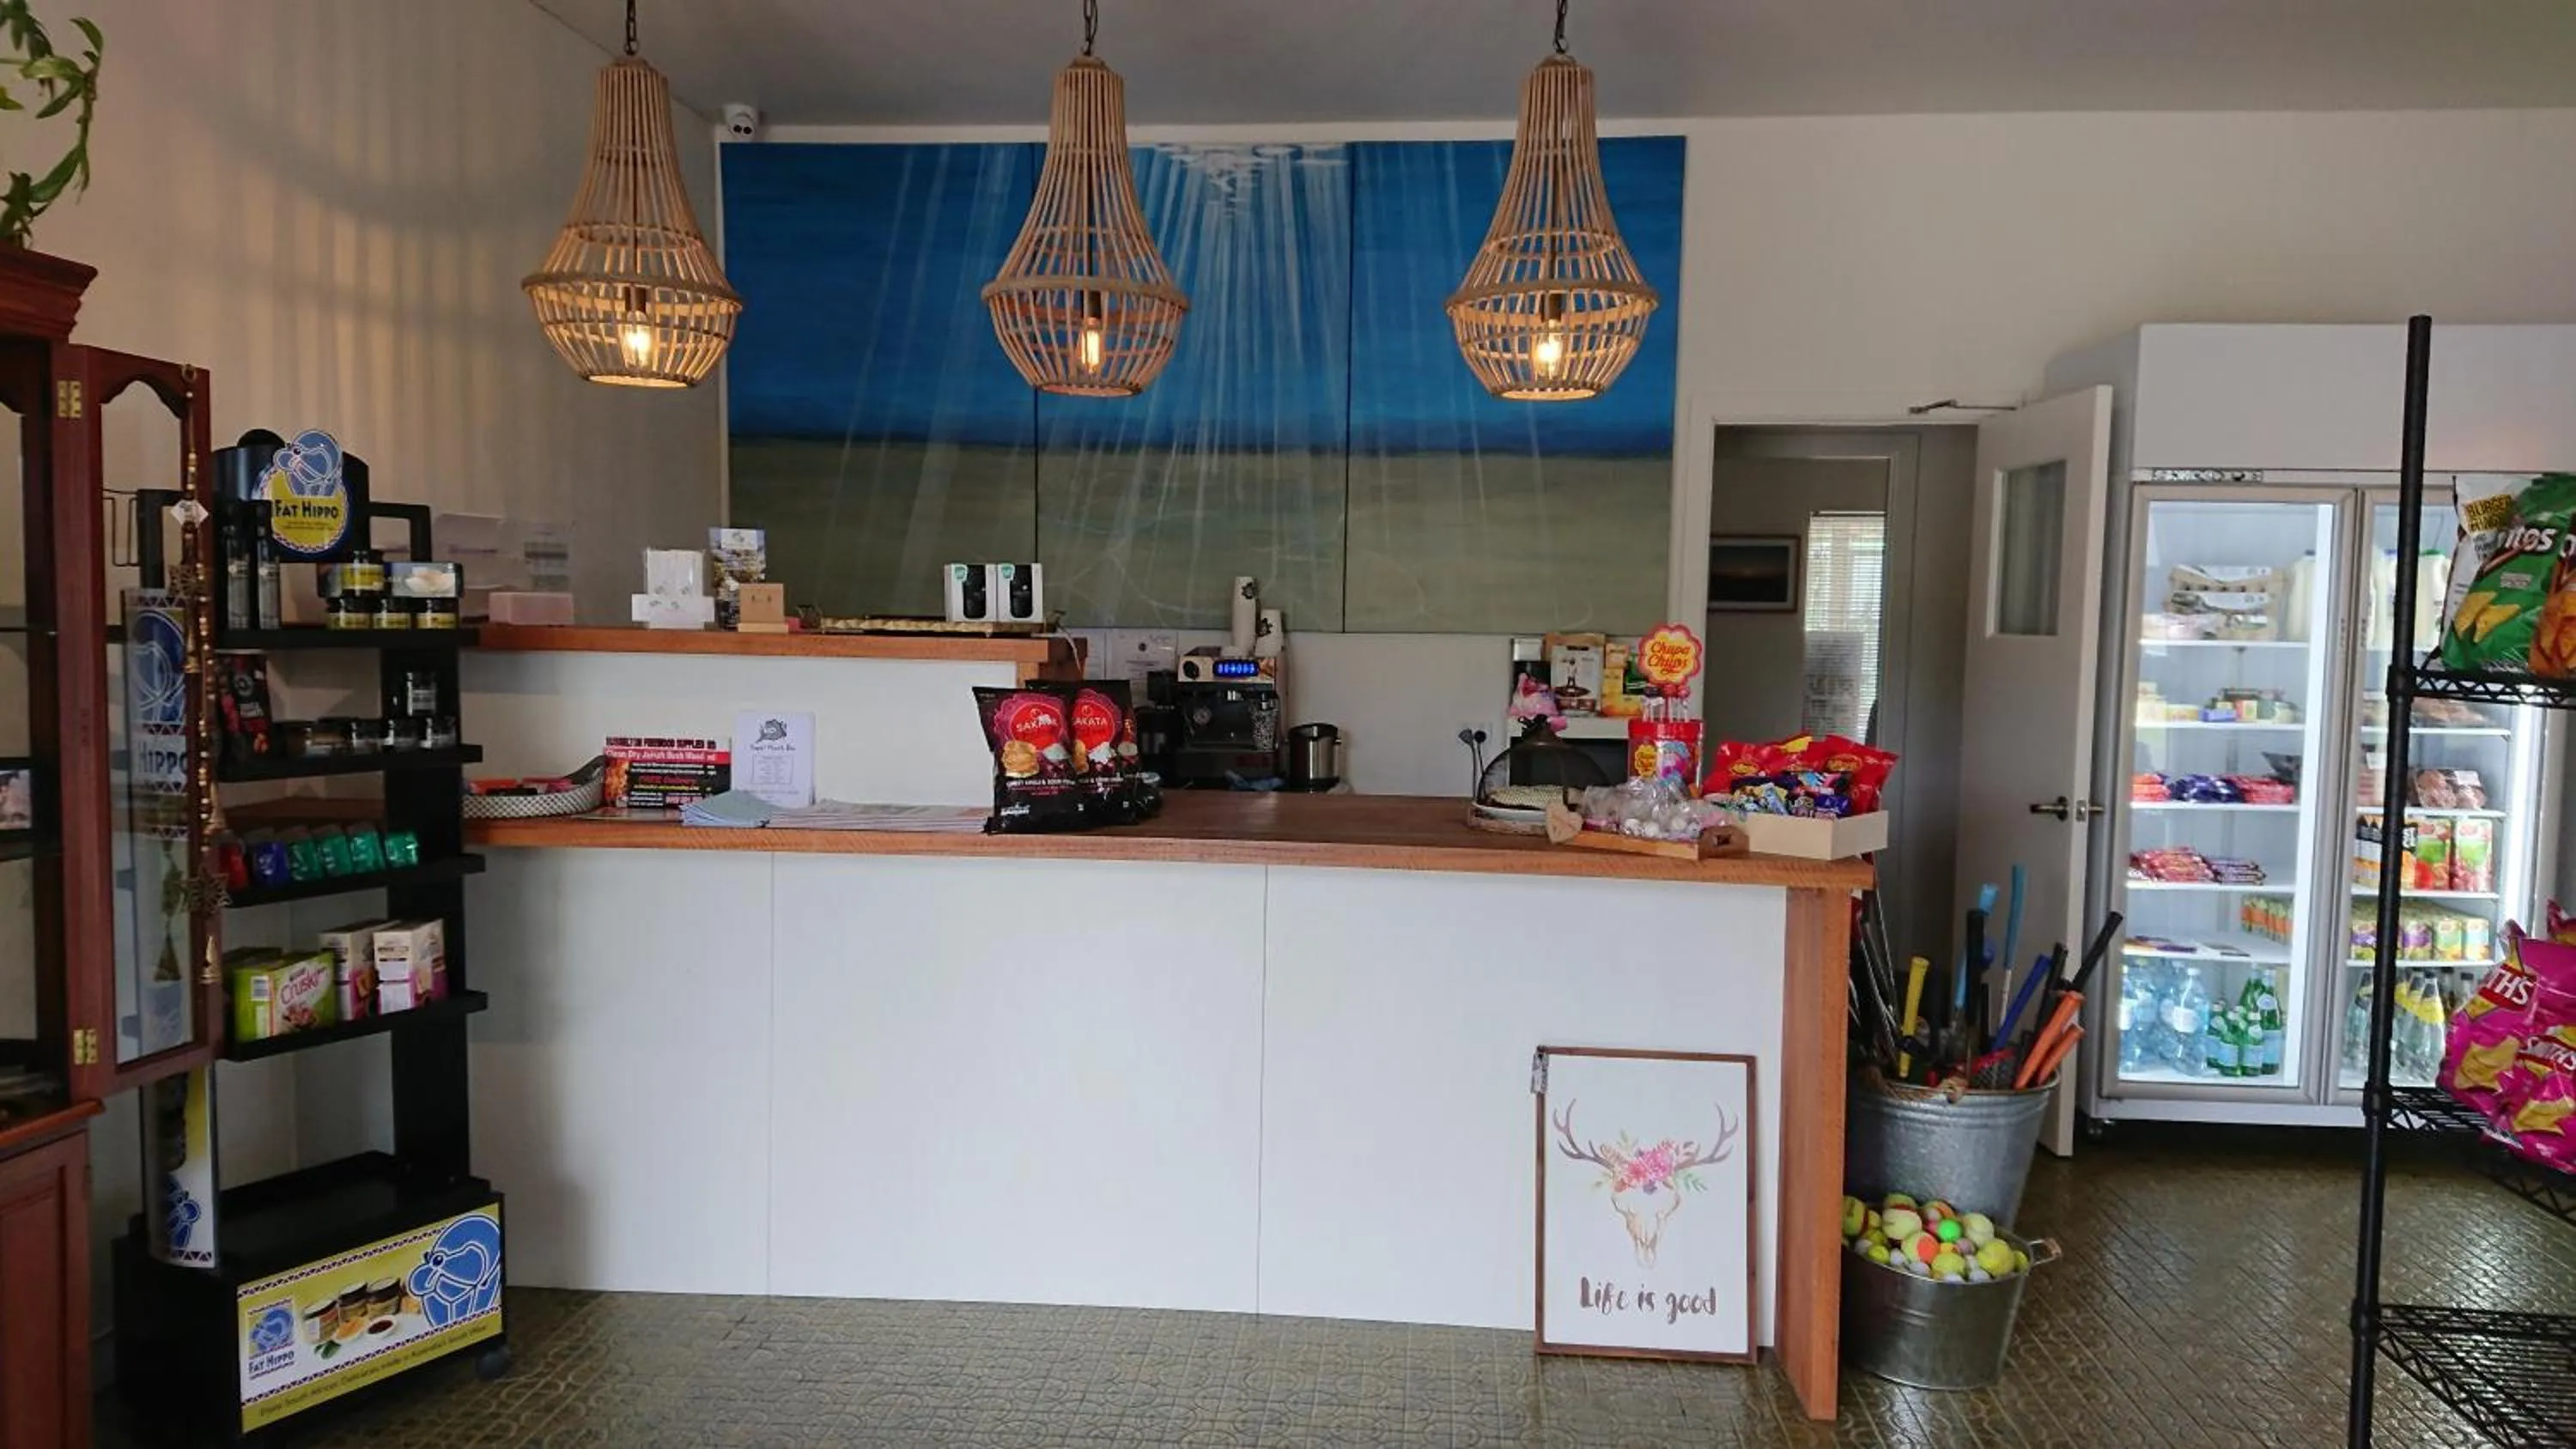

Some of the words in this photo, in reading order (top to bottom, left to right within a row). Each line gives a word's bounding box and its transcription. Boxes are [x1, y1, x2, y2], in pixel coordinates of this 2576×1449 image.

[275, 499, 298, 518] FAT
[301, 500, 339, 518] HIPPO
[1650, 641, 1691, 656] Chupa
[1016, 714, 1059, 731] SAKA
[1580, 1276, 1629, 1315] Life
[1637, 1283, 1656, 1312] is
[1666, 1287, 1716, 1325] good
[249, 1359, 265, 1373] FAT
